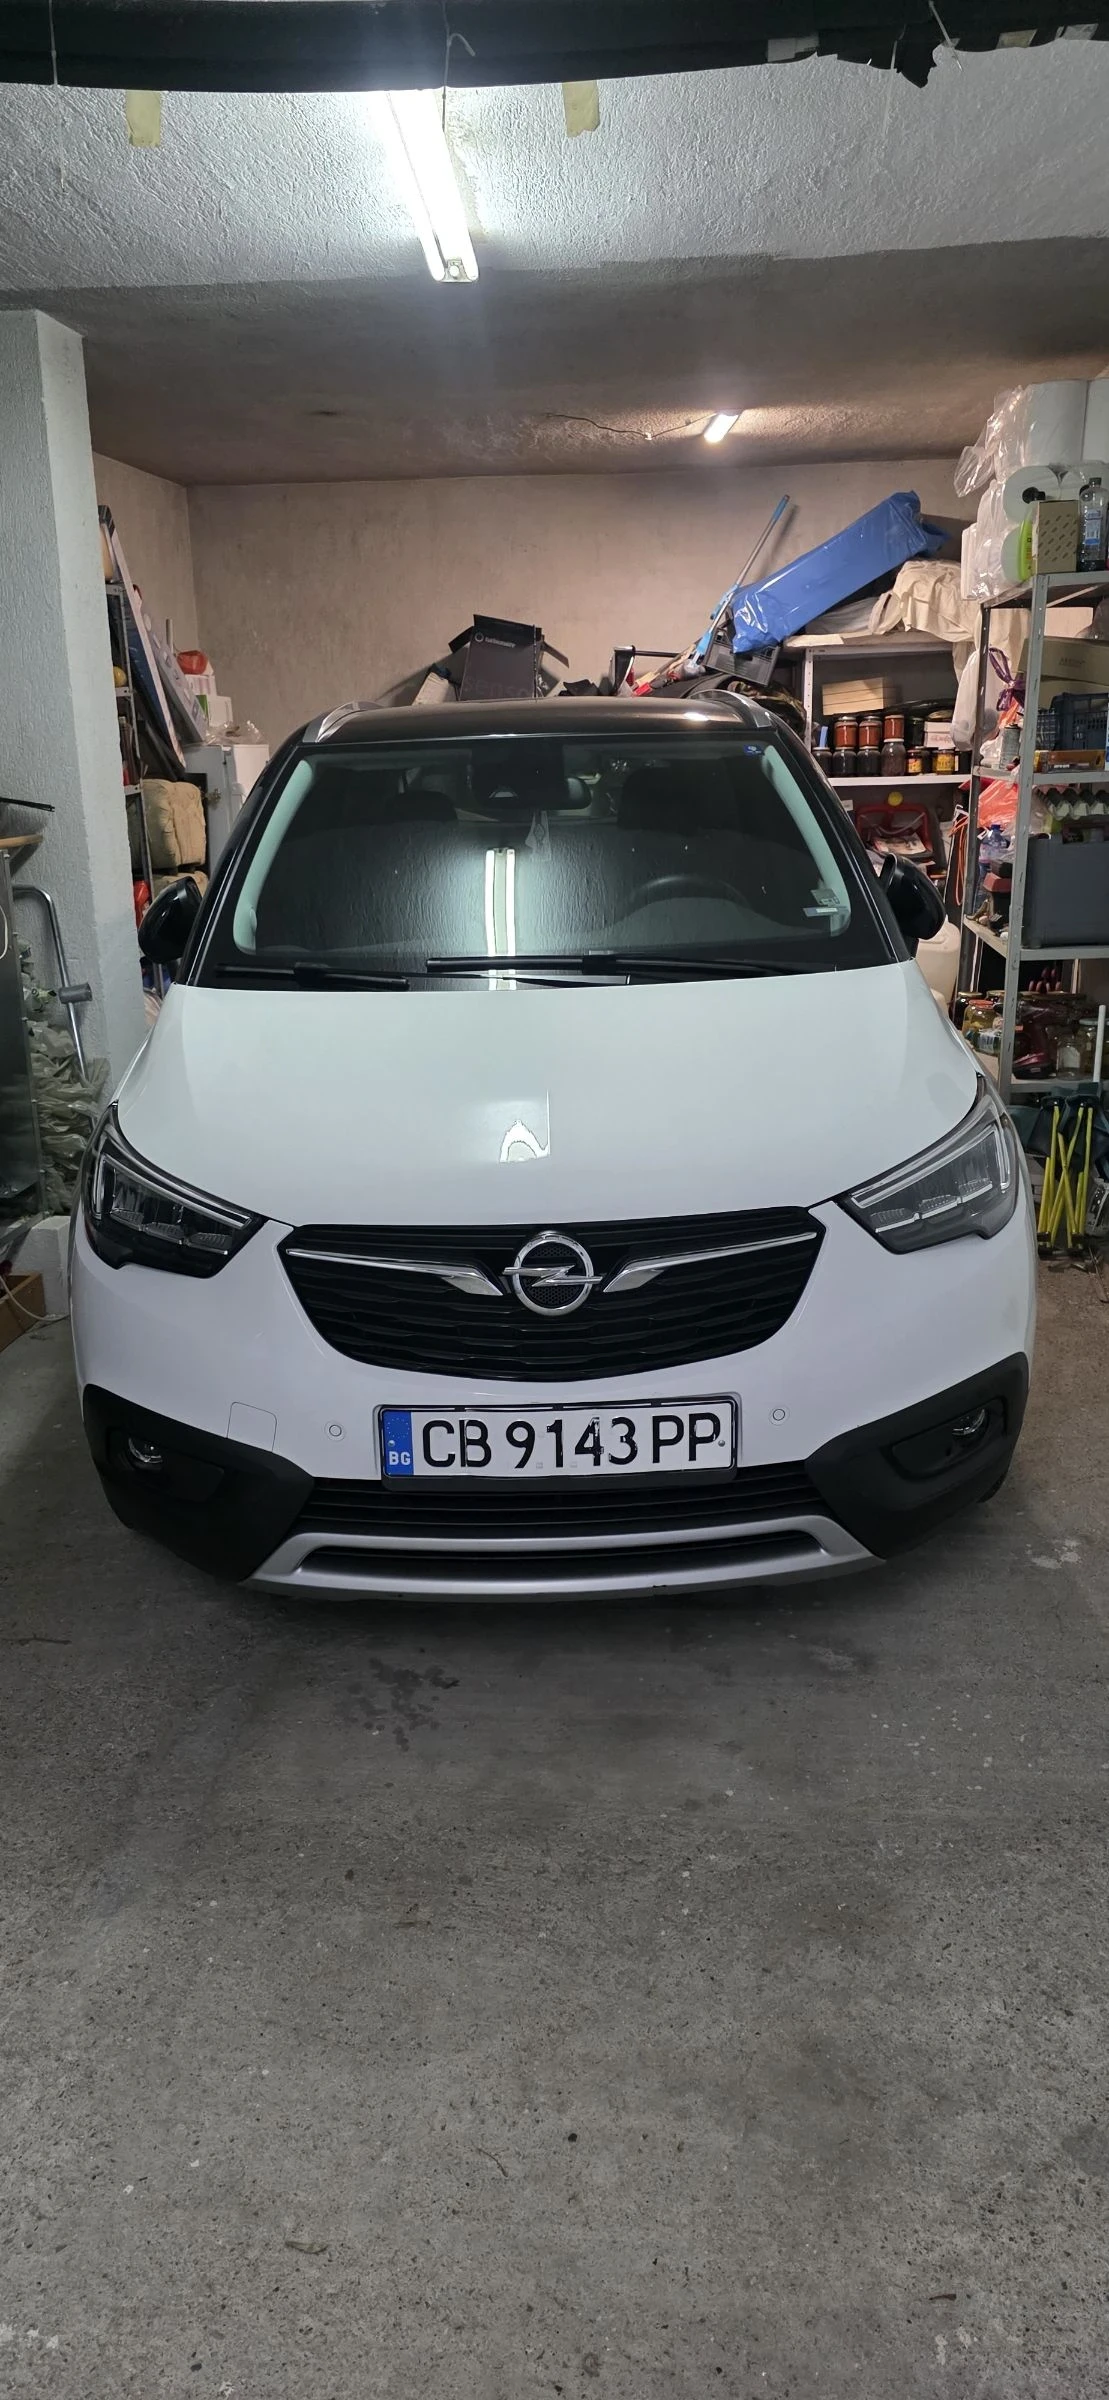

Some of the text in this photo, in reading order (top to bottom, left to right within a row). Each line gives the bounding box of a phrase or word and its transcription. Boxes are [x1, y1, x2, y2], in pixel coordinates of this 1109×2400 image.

[389, 1451, 411, 1466] BG
[422, 1412, 721, 1469] CB 9143 PP
